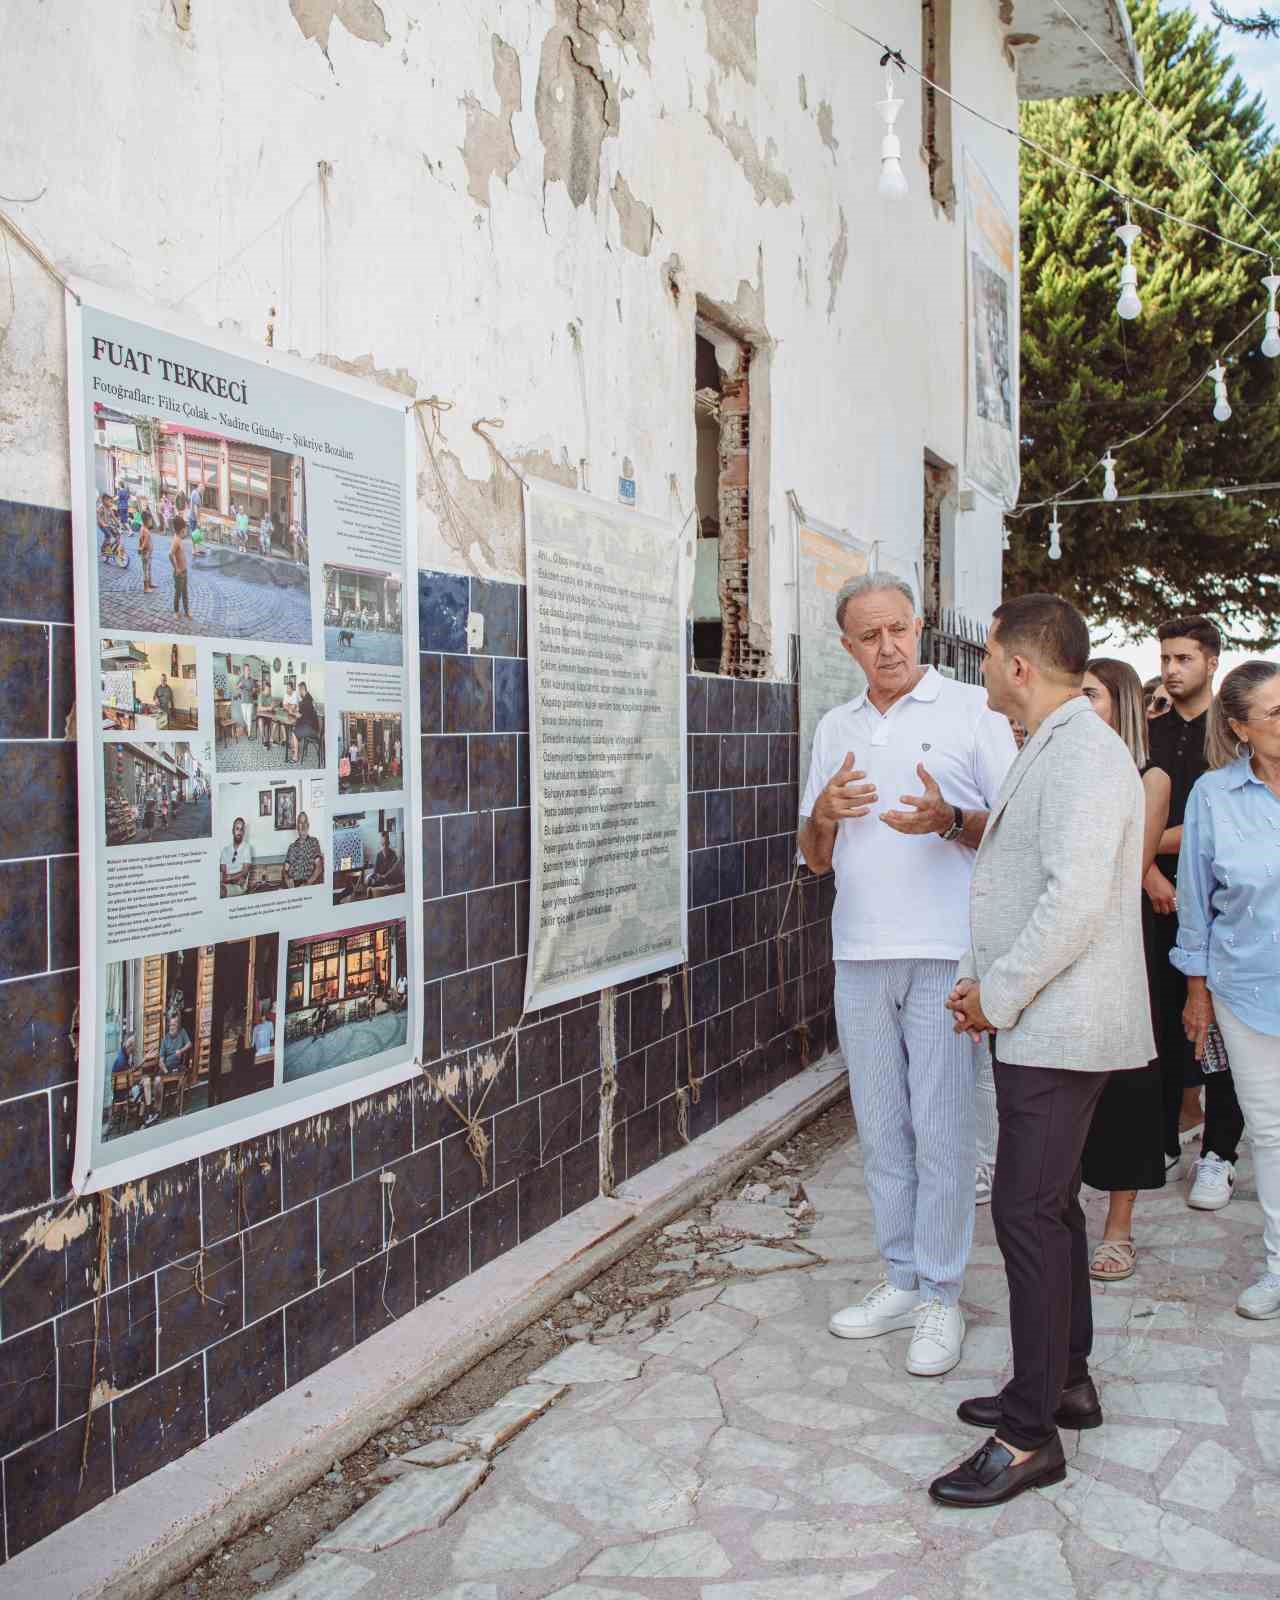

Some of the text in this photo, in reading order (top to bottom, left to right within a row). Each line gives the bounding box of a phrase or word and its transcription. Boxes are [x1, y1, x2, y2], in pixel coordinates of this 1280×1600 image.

[92, 336, 249, 405] FUAT TEKKECİ
[92, 376, 155, 406] Fotoğraflar:
[158, 394, 181, 414] Filiz
[182, 402, 210, 423] Çolak
[219, 413, 250, 434] Nadire
[251, 421, 285, 446] Günday
[293, 432, 324, 455] Şükriye
